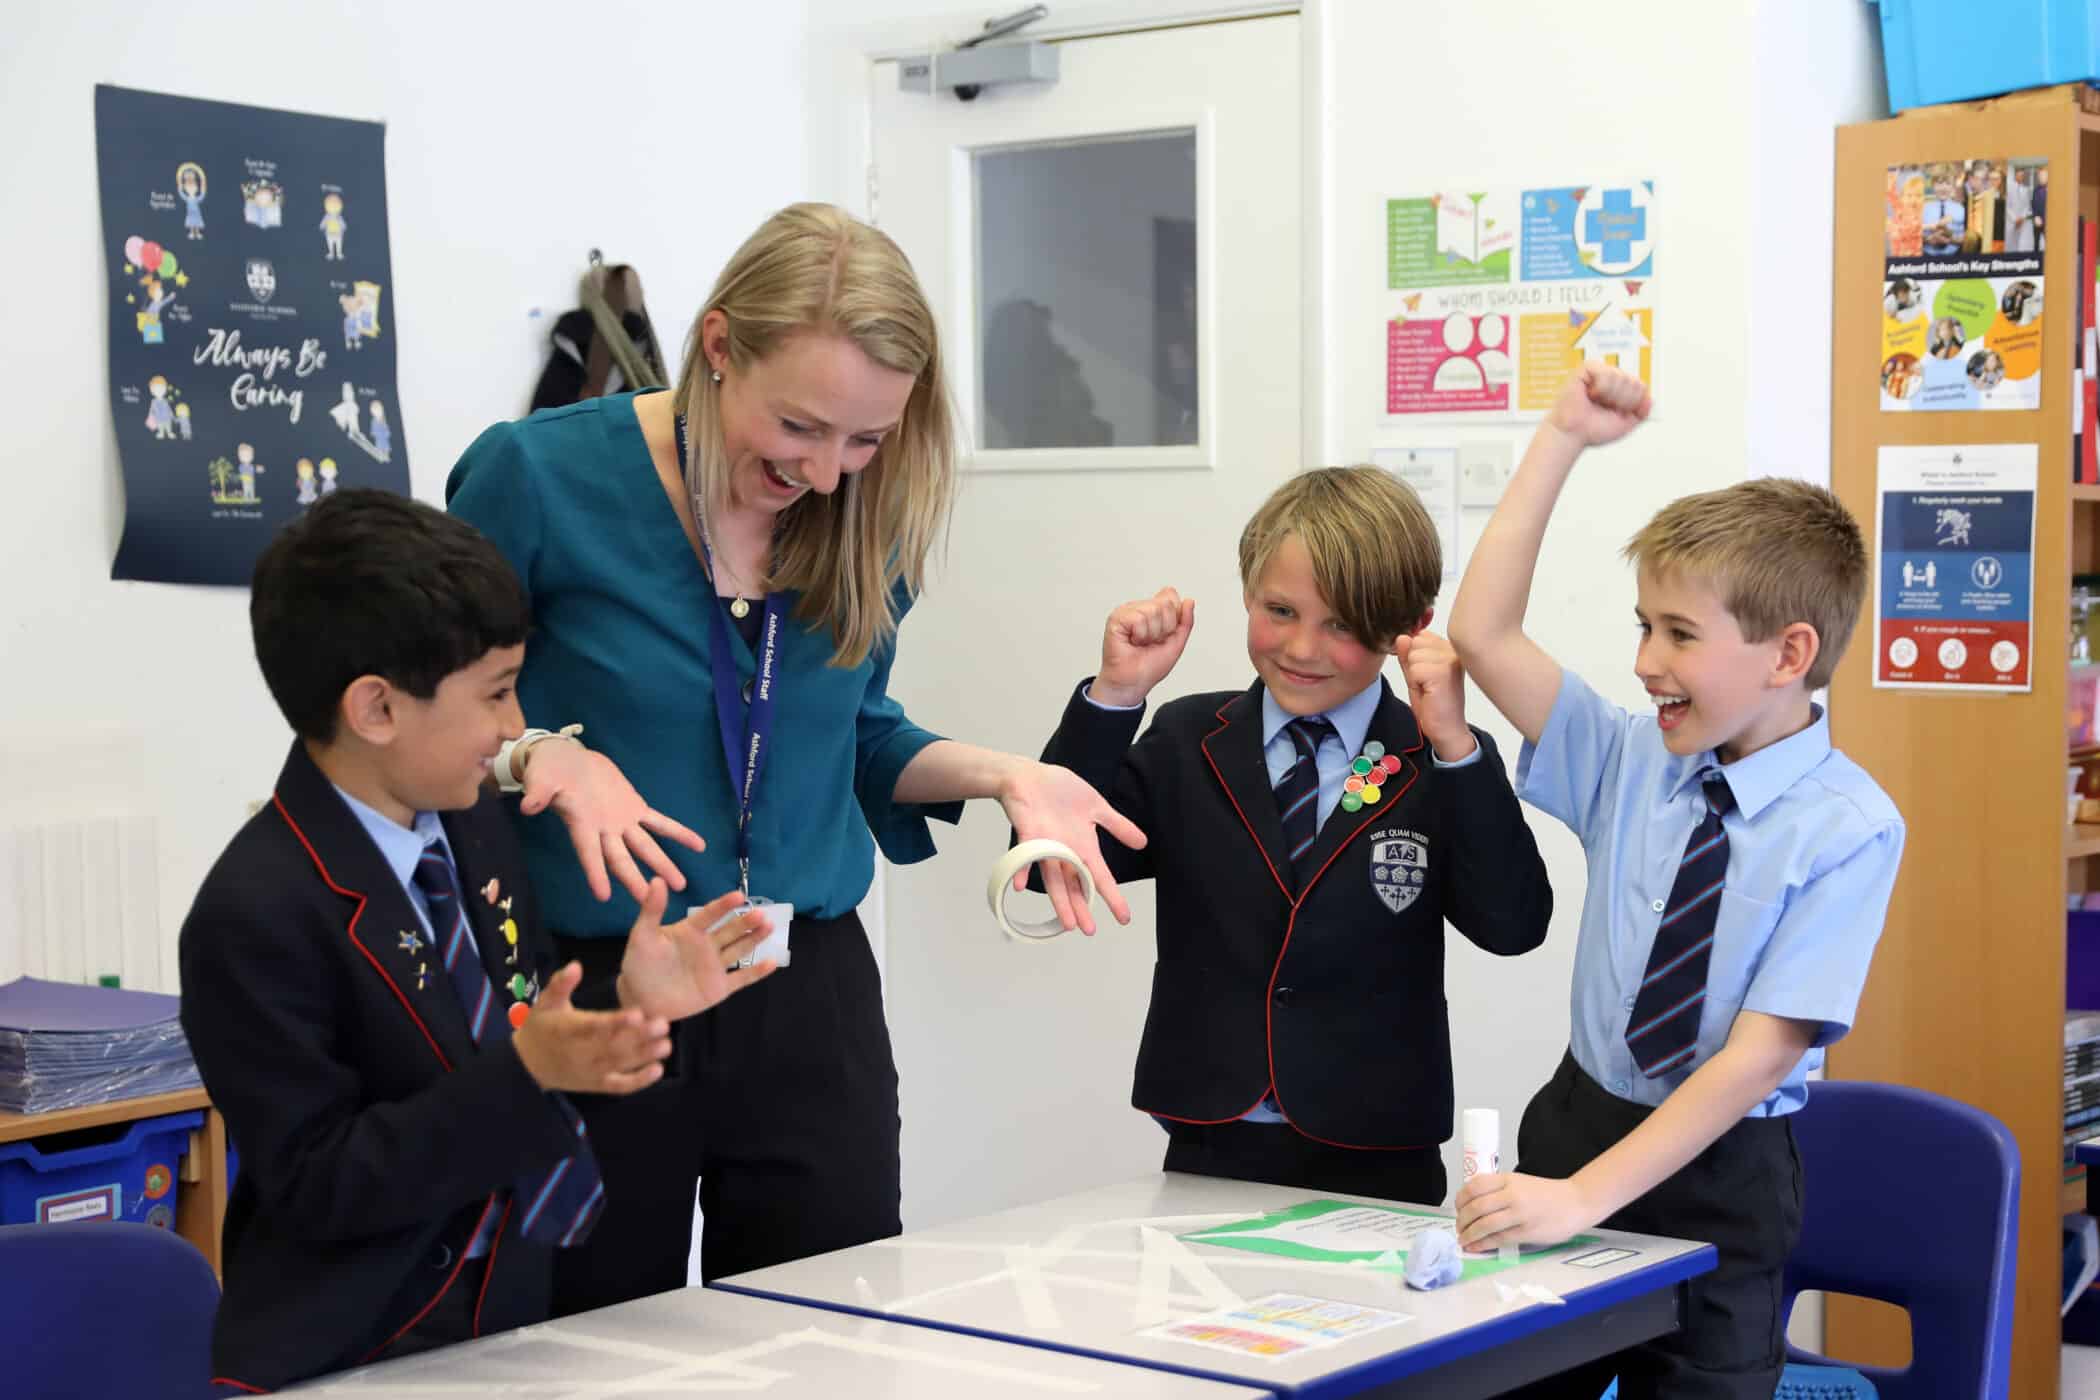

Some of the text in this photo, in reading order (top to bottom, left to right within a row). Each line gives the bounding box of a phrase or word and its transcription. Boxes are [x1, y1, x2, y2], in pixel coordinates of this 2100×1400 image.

[1970, 260, 1991, 275] Key
[1991, 258, 2040, 273] Strengths
[193, 328, 327, 380] Always Be
[230, 373, 304, 424] Caring
[760, 612, 778, 701] Ashford School Staff
[748, 732, 760, 767] Ashford
[1389, 829, 1410, 838] QUAM
